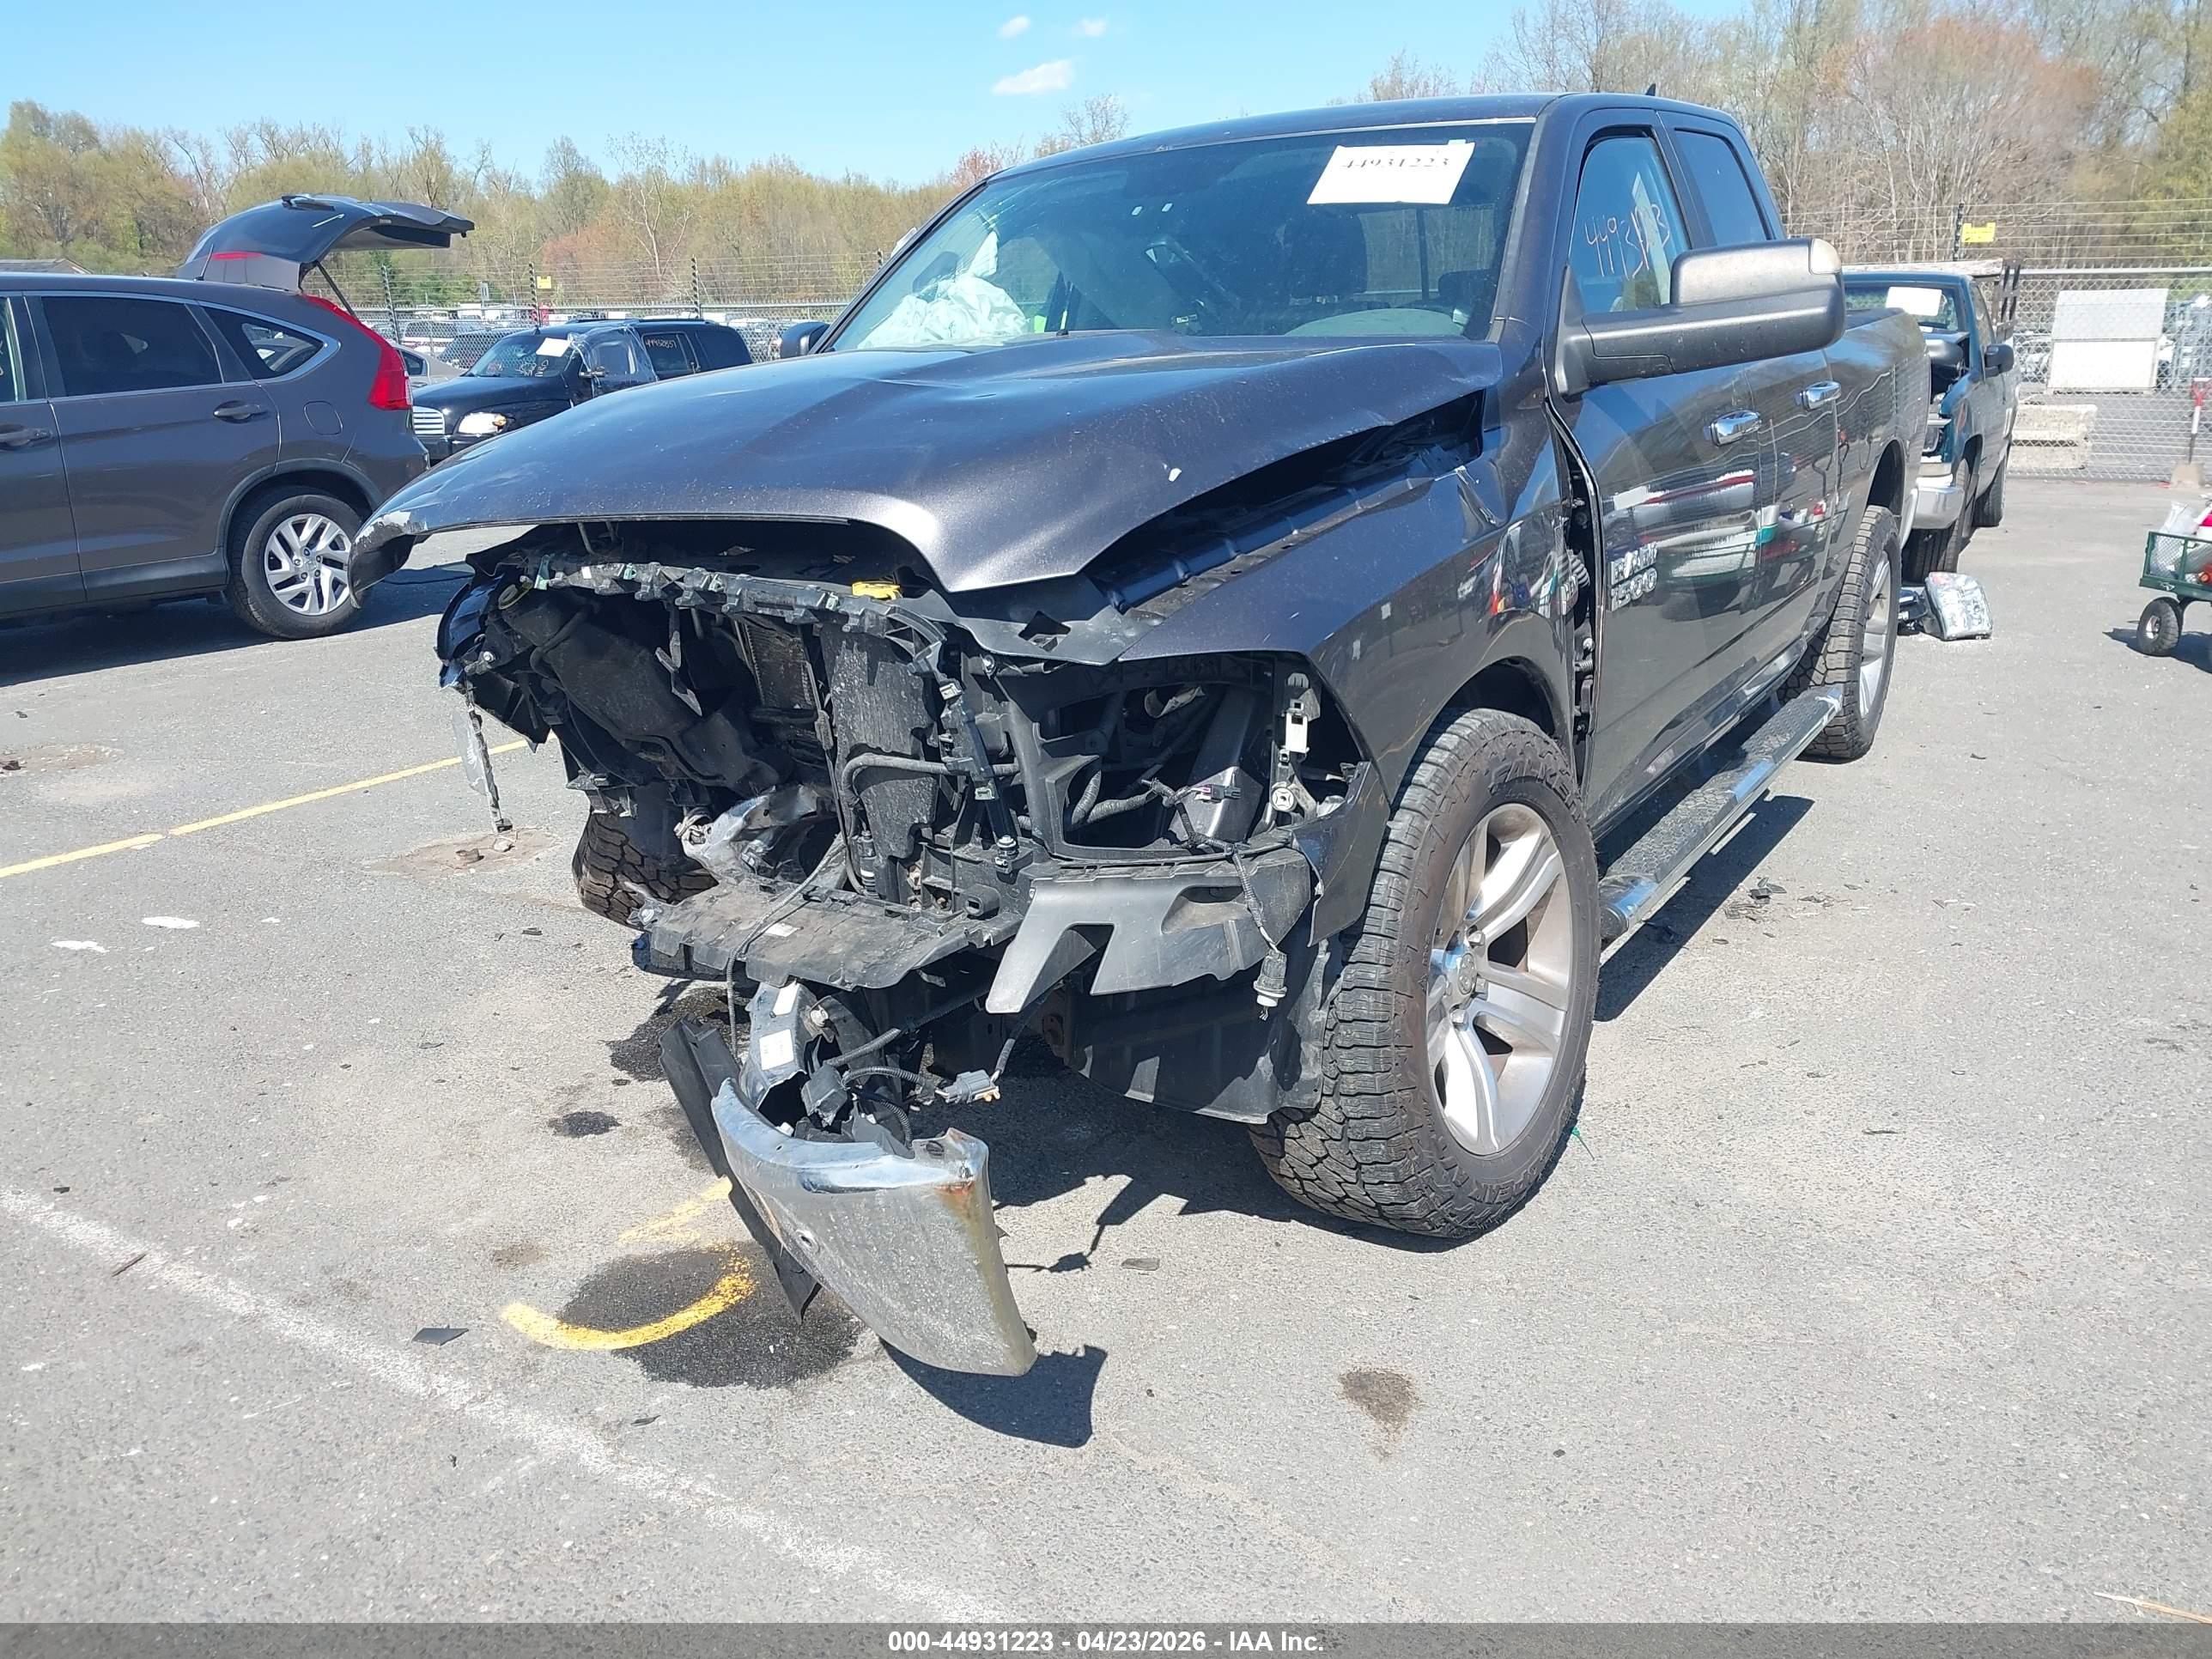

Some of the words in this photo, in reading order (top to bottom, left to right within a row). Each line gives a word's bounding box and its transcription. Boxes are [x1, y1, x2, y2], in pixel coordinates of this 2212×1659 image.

[1341, 156, 1450, 168] 44931223
[1610, 541, 1658, 586] RAM
[1610, 567, 1658, 612] 1500
